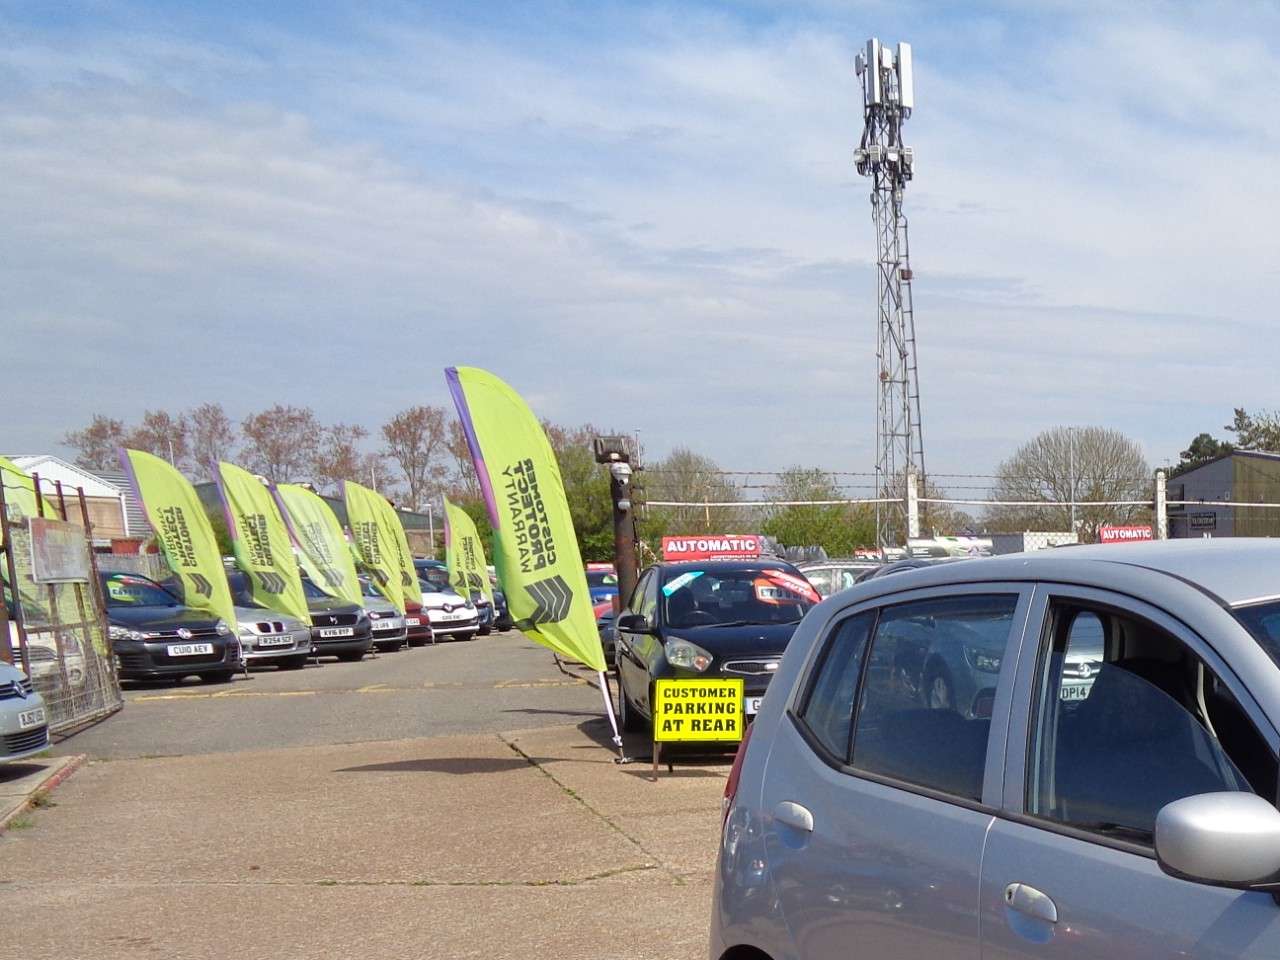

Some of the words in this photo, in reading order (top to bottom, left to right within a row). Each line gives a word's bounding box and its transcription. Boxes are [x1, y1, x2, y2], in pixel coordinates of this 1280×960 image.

[1103, 527, 1151, 540] AUTOMATIC
[667, 540, 757, 553] AUTOMATIC
[663, 687, 736, 698] CUSTOMER
[663, 702, 736, 714] PARKING
[662, 719, 684, 732] AT
[690, 719, 736, 732] REAR
